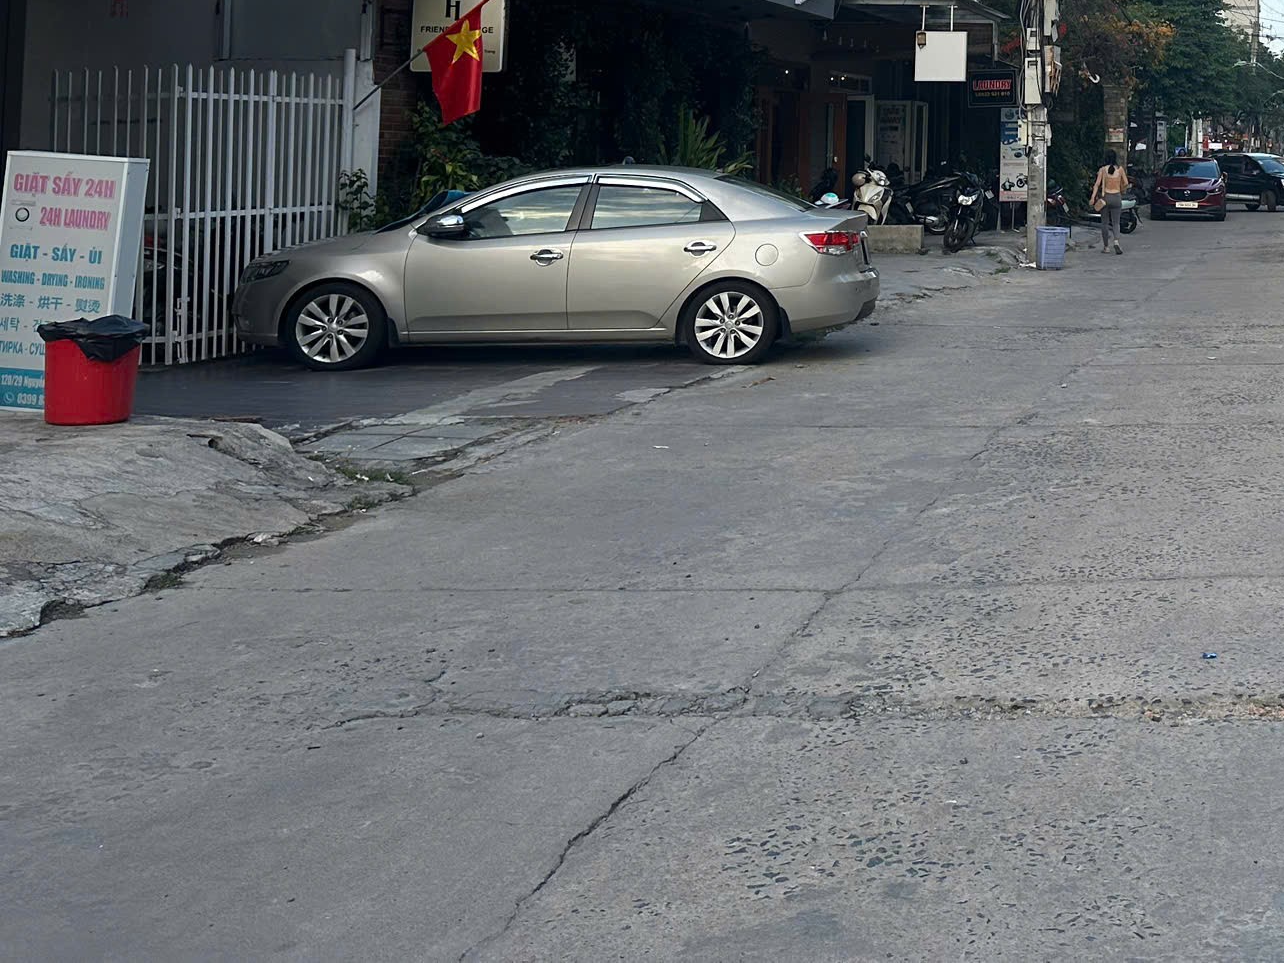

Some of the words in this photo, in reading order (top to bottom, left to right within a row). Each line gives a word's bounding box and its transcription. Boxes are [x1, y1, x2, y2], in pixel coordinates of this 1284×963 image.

[973, 79, 1012, 91] LAUNDRY
[13, 172, 49, 197] GIẶT
[52, 171, 83, 197] SẤY
[84, 178, 116, 198] 24H
[40, 206, 62, 227] 24H
[64, 208, 111, 231] LAUNDRY
[10, 243, 40, 262] GIẶT
[51, 243, 77, 263] SẤY
[1, 270, 35, 286] WASHING
[42, 273, 68, 288] DRYING
[75, 276, 105, 290] IRONING
[0, 293, 25, 308] 洗涤
[37, 295, 63, 310] 烘干
[75, 298, 101, 314] 熨烫
